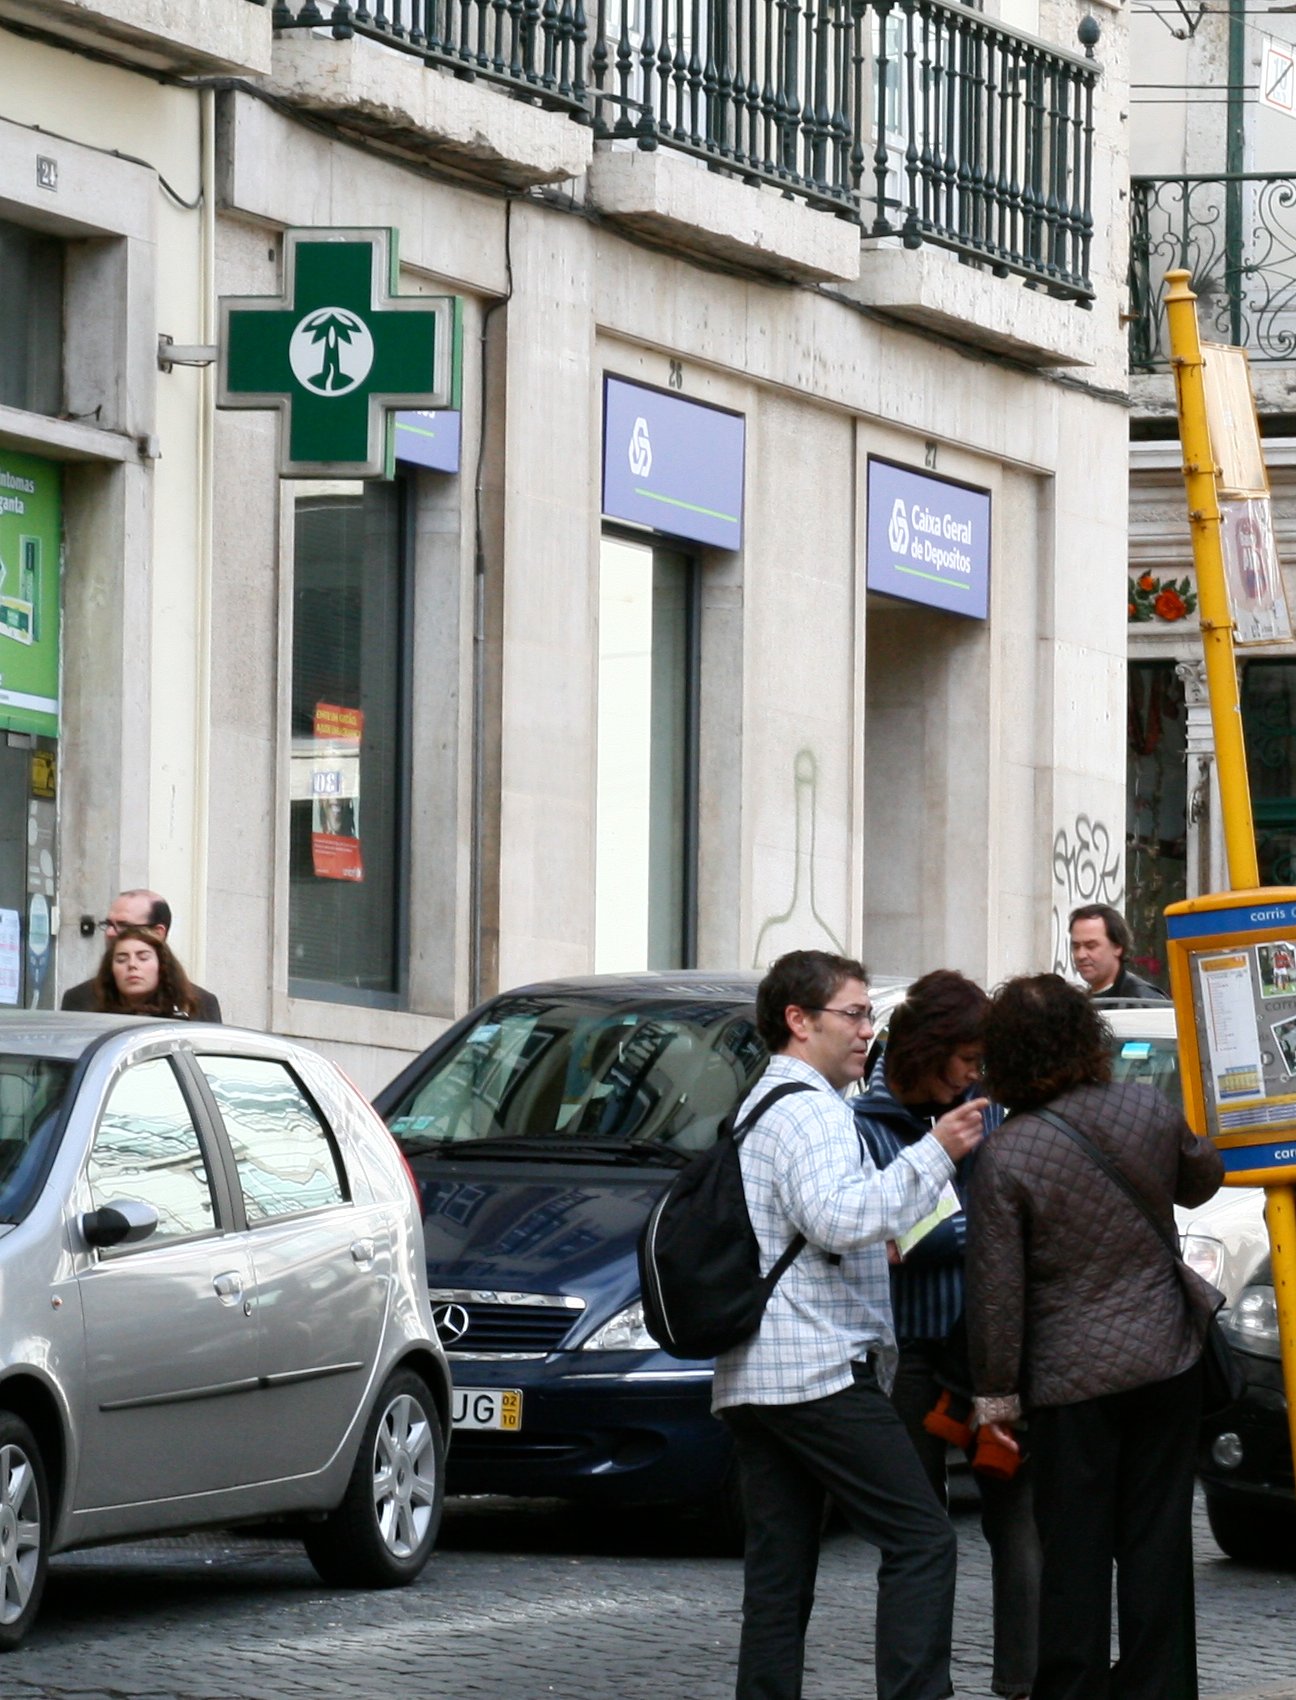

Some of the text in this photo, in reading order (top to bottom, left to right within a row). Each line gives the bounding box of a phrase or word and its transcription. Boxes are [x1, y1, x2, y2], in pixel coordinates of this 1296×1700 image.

[911, 504, 972, 545] Caixa Geral
[911, 537, 971, 574] de Depositos
[1250, 907, 1286, 922] carris
[502, 1395, 516, 1407] 02
[503, 1414, 516, 1425] 10
